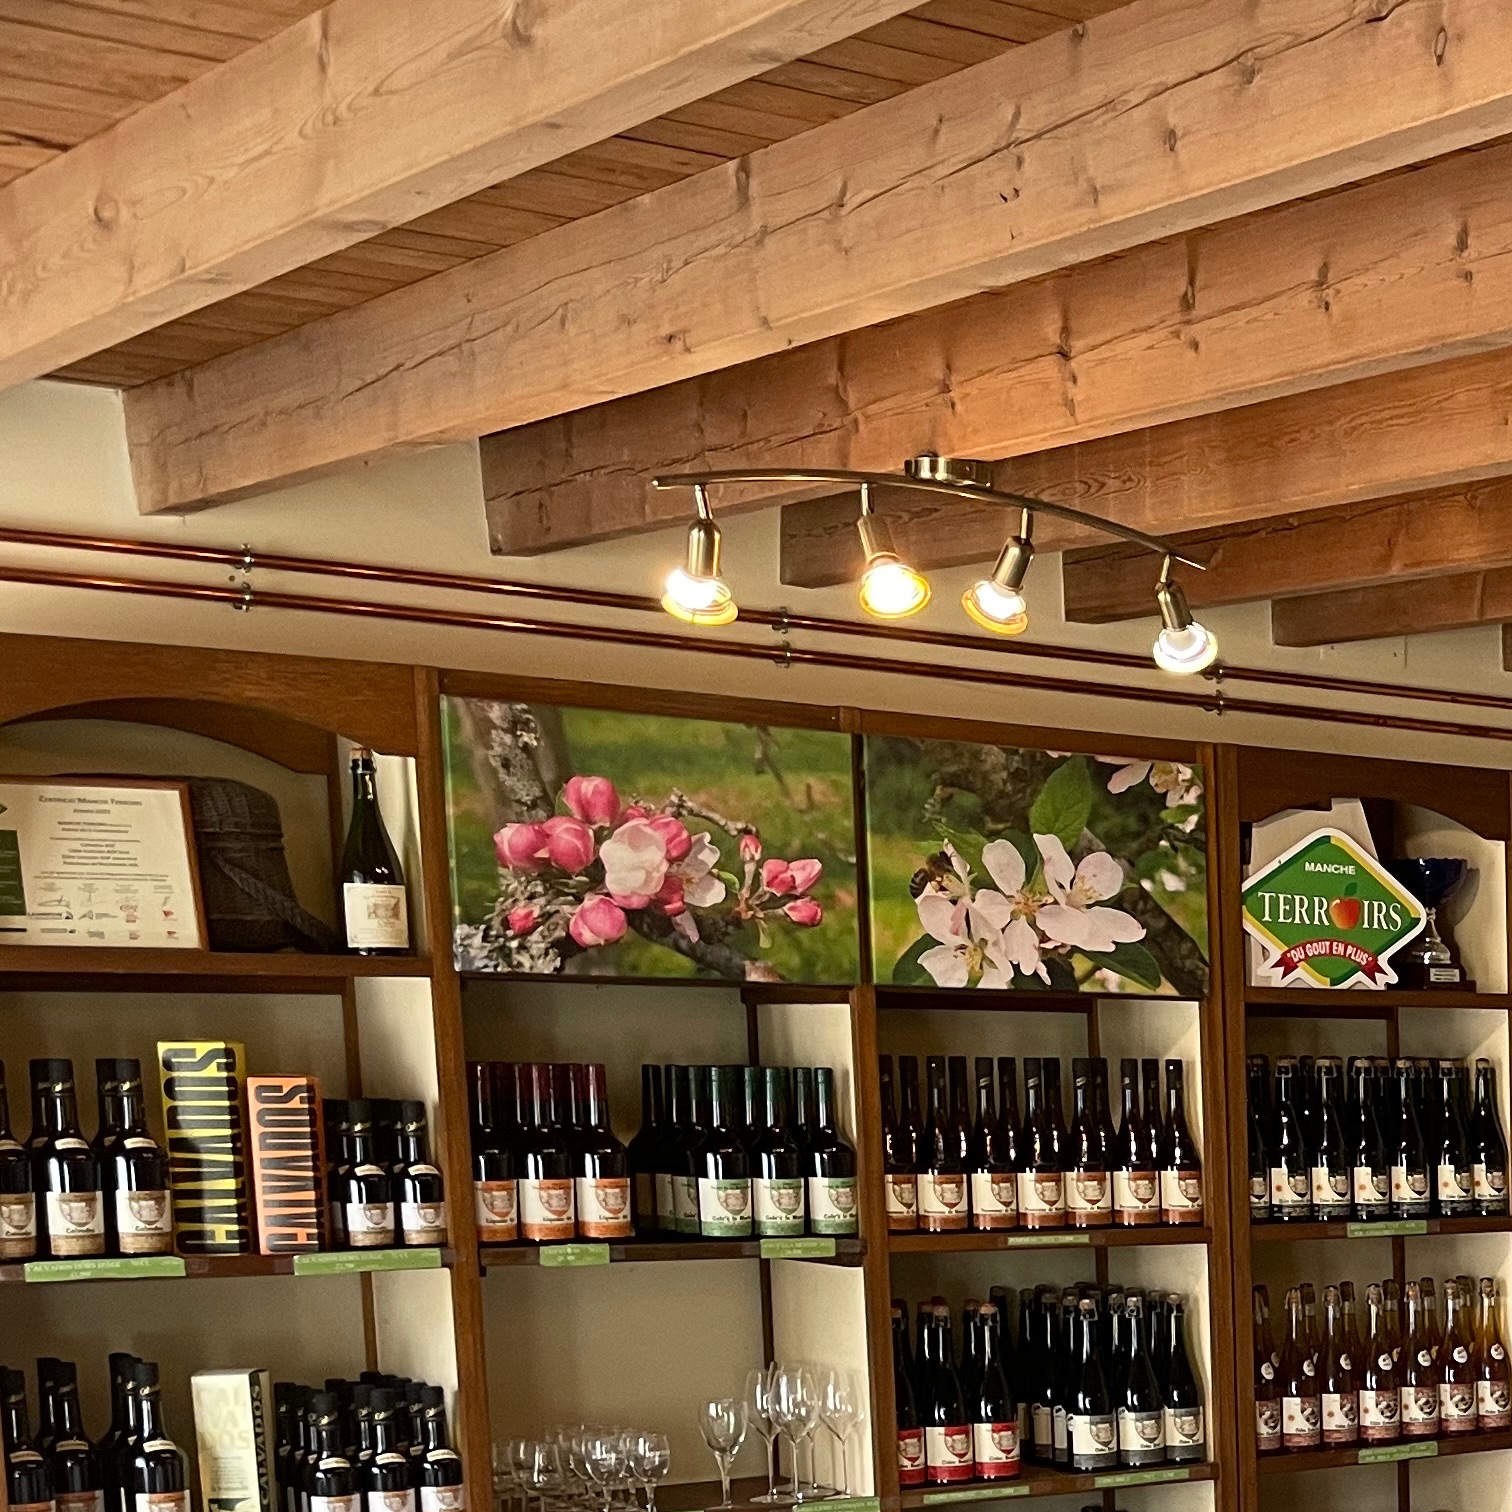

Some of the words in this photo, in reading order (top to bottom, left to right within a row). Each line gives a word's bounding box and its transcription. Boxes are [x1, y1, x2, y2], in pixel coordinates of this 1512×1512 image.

[1304, 861, 1356, 875] MANCHE
[1305, 941, 1333, 957] GOUT
[1333, 941, 1346, 956] EN
[162, 1046, 250, 1254] CALVADOS
[254, 1084, 325, 1252] CALVADOS
[251, 1385, 270, 1506] CALVADOS
